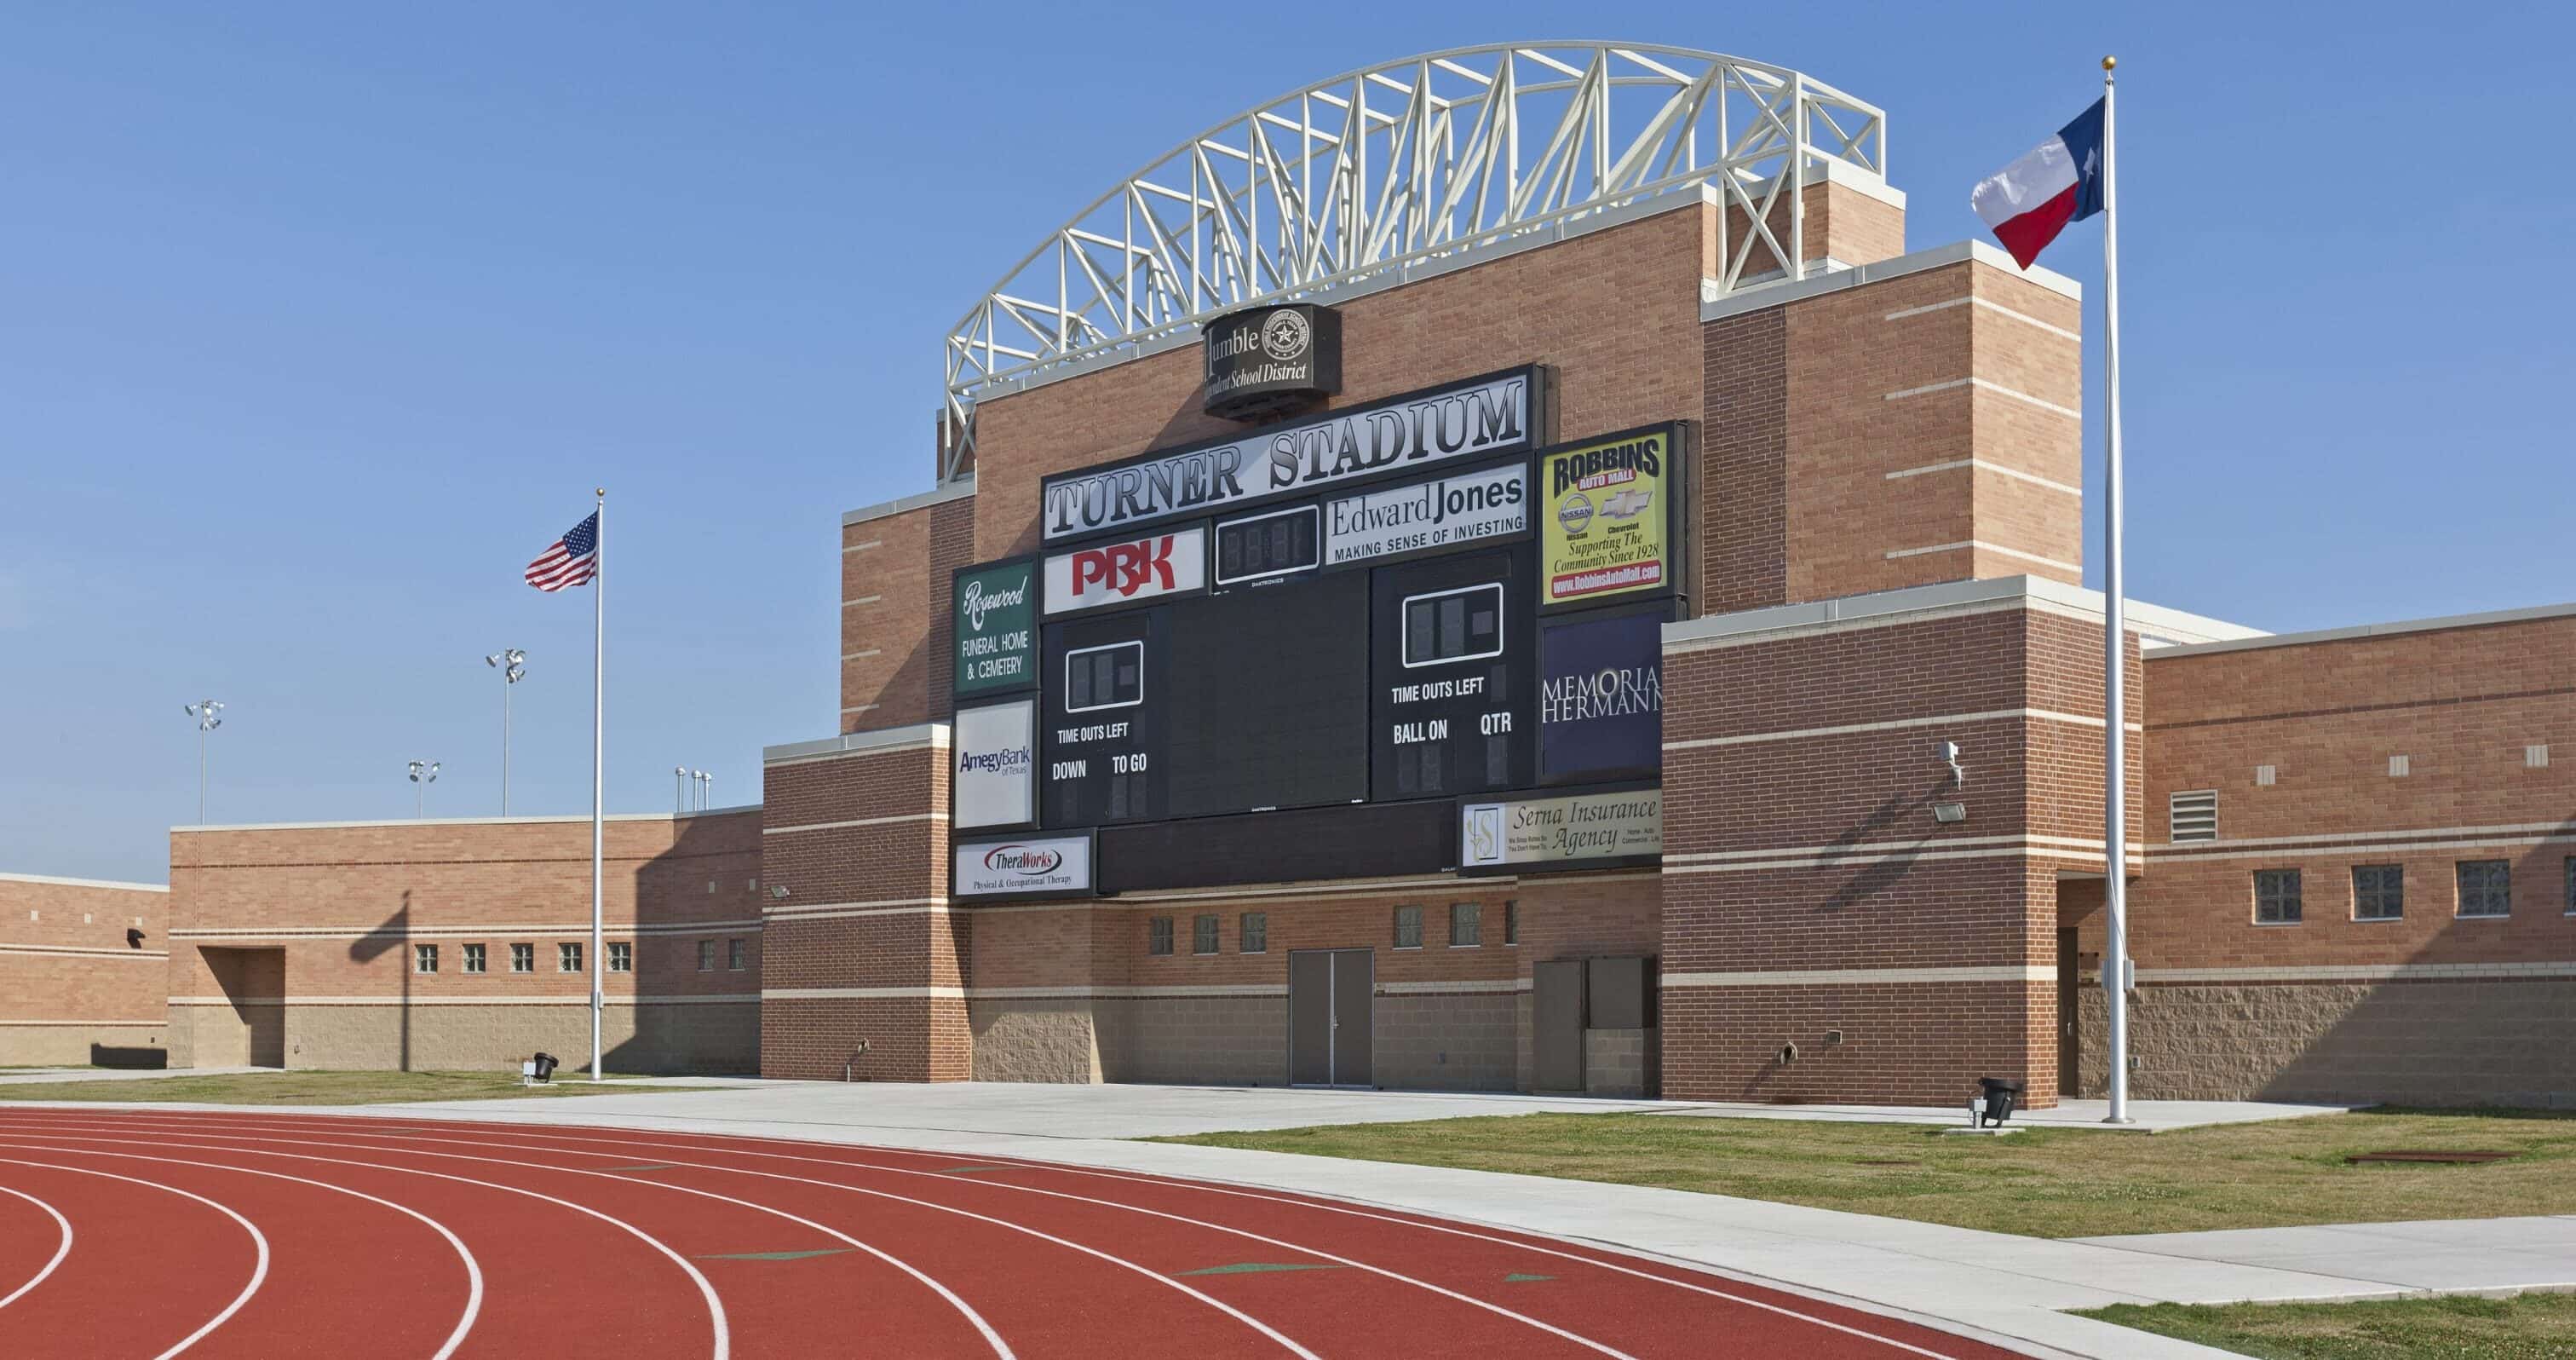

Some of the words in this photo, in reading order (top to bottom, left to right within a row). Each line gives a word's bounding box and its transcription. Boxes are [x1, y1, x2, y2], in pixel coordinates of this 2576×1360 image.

[1231, 364, 1262, 389] School
[1263, 360, 1308, 383] District
[1049, 446, 1244, 533] TURNER
[1270, 380, 1523, 489] STADIUM
[1553, 439, 1660, 498] ROBBINS
[1579, 475, 1606, 489] AUTO
[1607, 469, 1635, 487] MALL
[1561, 508, 1591, 519] NISSAN
[1335, 542, 1381, 562] MAKING
[1387, 533, 1427, 552] SENSE
[1433, 529, 1448, 544] OF
[1454, 516, 1523, 539] INVESTING
[1569, 536, 1622, 556] Supporting
[1624, 531, 1643, 546] The
[1072, 535, 1175, 596] PBK
[1554, 553, 1607, 573] Community
[1608, 550, 1635, 564] Since
[1636, 542, 1659, 560] 1928
[1553, 565, 1660, 594] www.RobbinsAutoMall.com
[963, 575, 1028, 631] Rosewood
[963, 636, 998, 657] FUNERAL
[1002, 631, 1028, 651] HOME
[968, 663, 975, 680] &
[979, 655, 1023, 678] CEMETERY
[1391, 685, 1419, 704] TIME
[1422, 680, 1452, 700] OUTS
[1456, 677, 1485, 695] LEFT
[1543, 666, 1662, 702] MEMORIA
[1057, 728, 1078, 744] TIME
[1080, 725, 1105, 741] OUTS
[1107, 722, 1129, 738] LEFT
[1394, 722, 1426, 744] BALL
[1429, 719, 1447, 741] ON
[1481, 712, 1512, 735] QTR
[1009, 766, 1027, 775] Texas
[1053, 759, 1086, 780] DOWN
[1113, 755, 1127, 774] TO
[1130, 753, 1147, 772] GO
[1513, 805, 1564, 830] Serna
[1569, 800, 1657, 824] Insurance
[1551, 827, 1619, 856] Agency
[996, 851, 1053, 870] TheraWorks
[974, 880, 997, 890] Physical
[998, 879, 1004, 888] &
[1006, 875, 1045, 888] Occupational
[1048, 874, 1072, 885] Therapy
